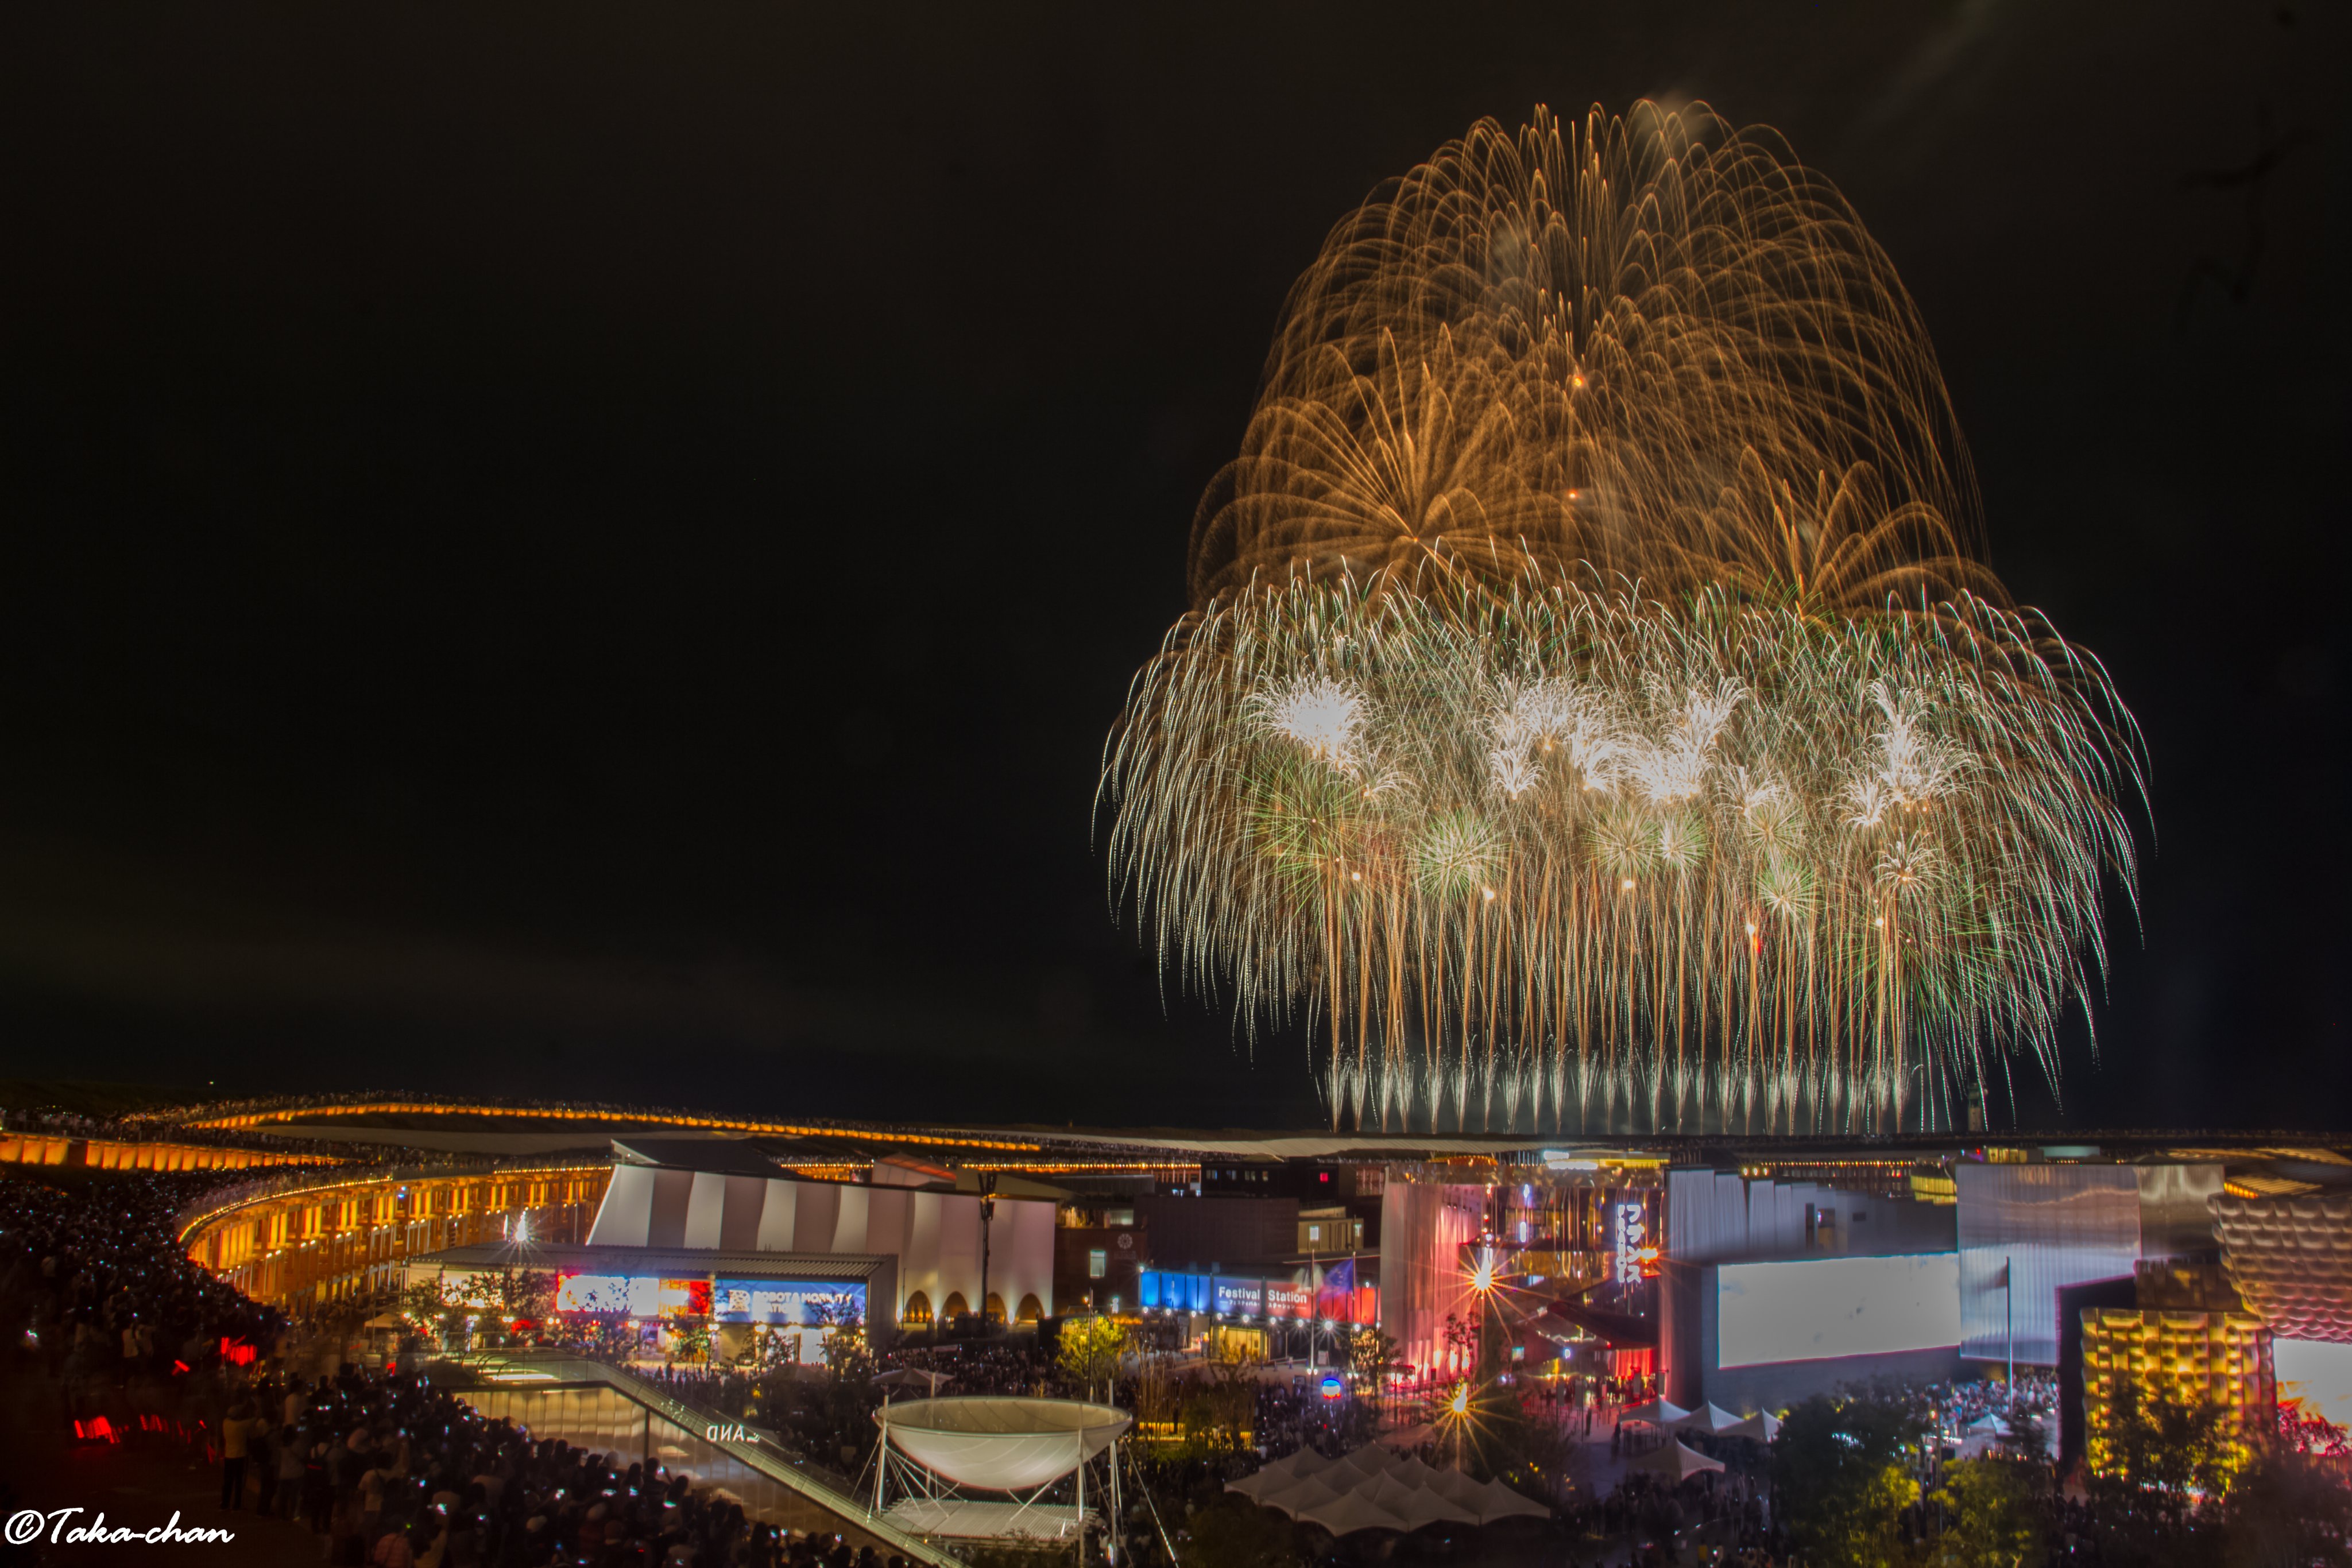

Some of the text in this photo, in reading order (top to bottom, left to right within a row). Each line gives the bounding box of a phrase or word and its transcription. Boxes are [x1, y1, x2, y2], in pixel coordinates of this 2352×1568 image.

[1626, 1205, 1642, 1283] フランス
[1218, 1286, 1307, 1304] Festival Station
